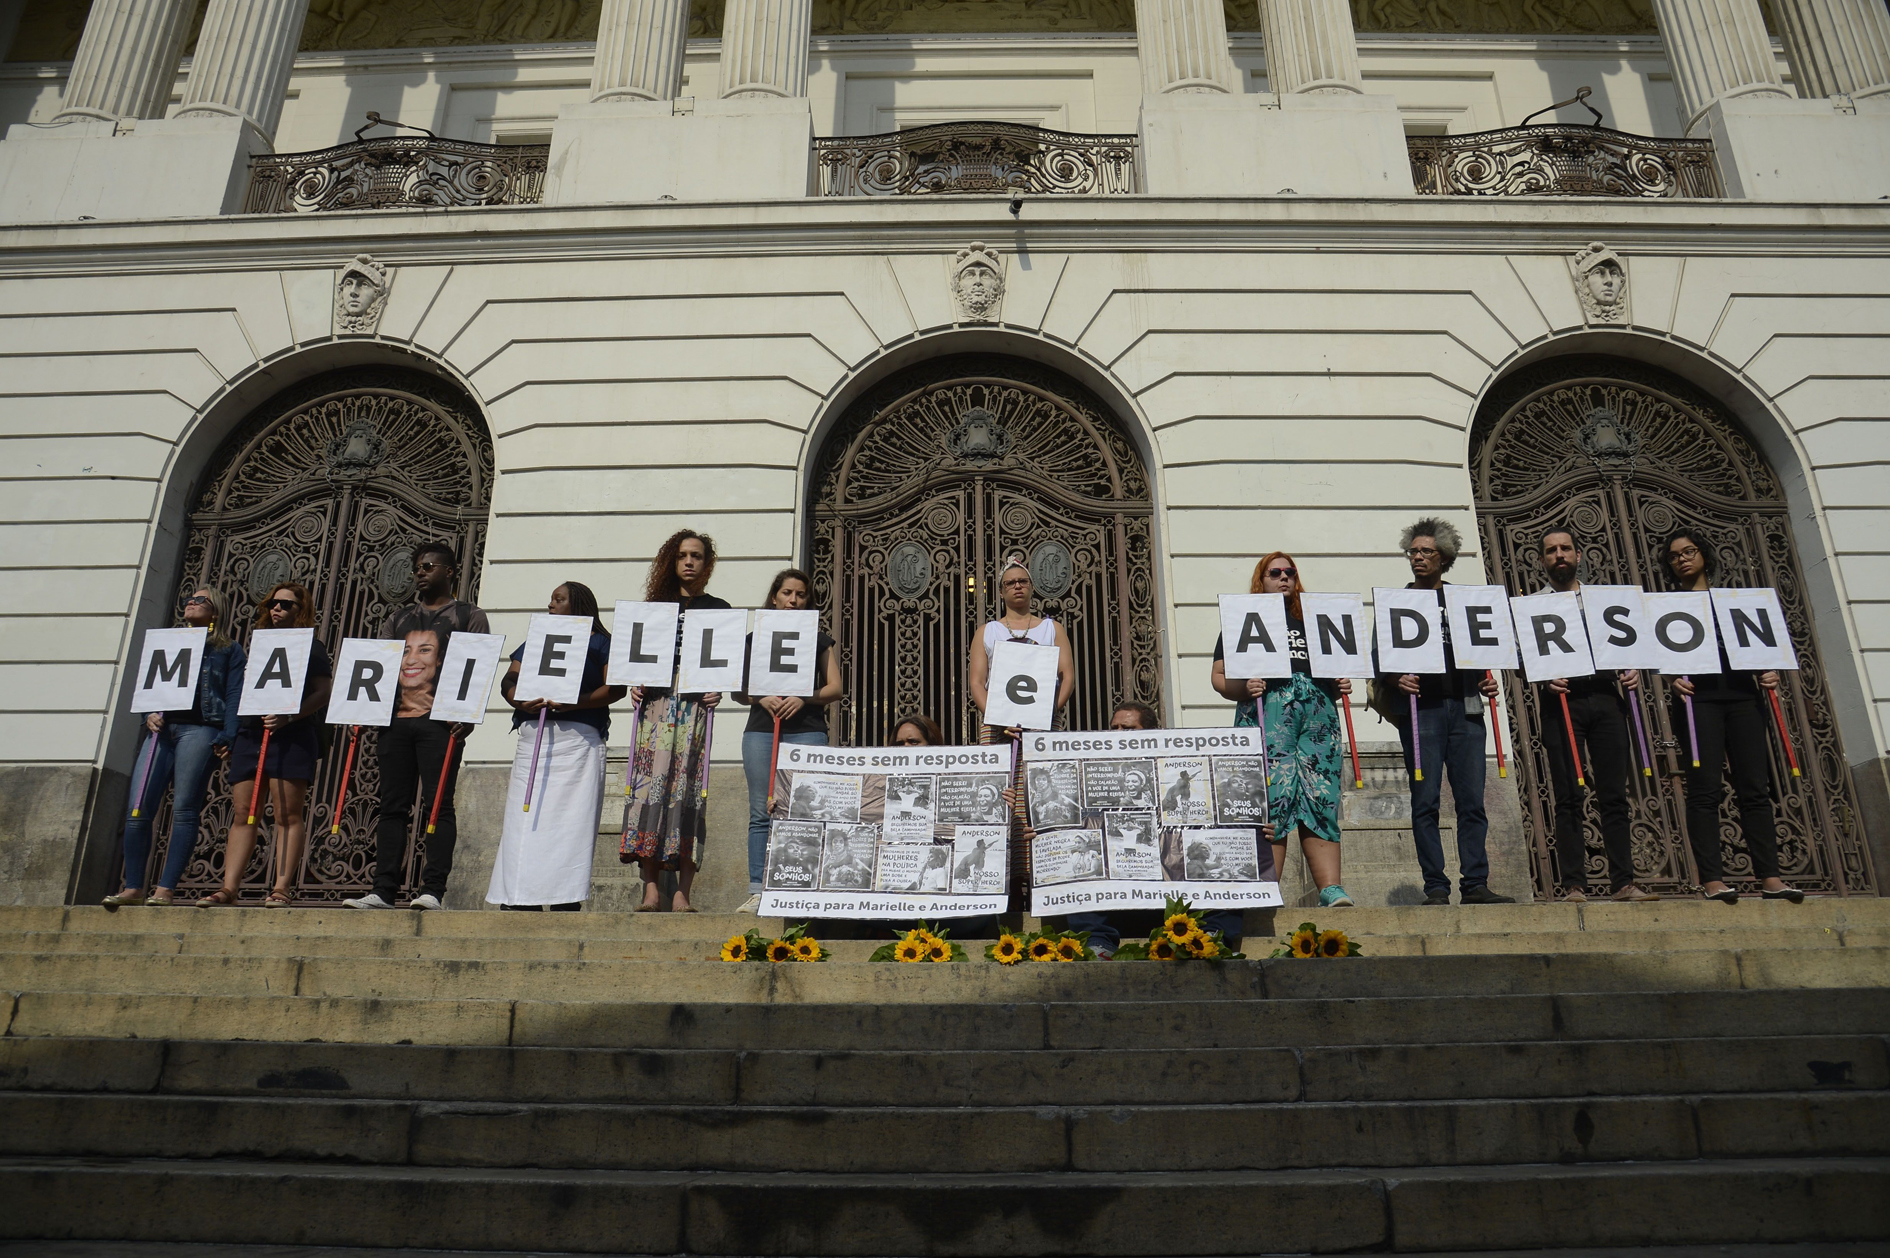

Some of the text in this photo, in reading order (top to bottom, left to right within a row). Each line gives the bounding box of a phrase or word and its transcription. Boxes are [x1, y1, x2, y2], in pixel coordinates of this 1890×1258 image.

[628, 622, 658, 664] L
[1236, 612, 1277, 653] A
[1316, 613, 1358, 655] N
[1389, 607, 1430, 649] D
[1464, 605, 1499, 646] E
[1530, 613, 1576, 656] R
[1602, 605, 1638, 647] S
[1654, 611, 1705, 653] O
[1729, 608, 1778, 648] N
[143, 647, 193, 690] M
[254, 647, 292, 689] A
[537, 633, 573, 677] E
[699, 628, 729, 668] L
[769, 630, 800, 673] E
[346, 659, 384, 703] R
[456, 658, 477, 701] I
[1005, 674, 1038, 705] e
[789, 748, 999, 769] 6 meses sem resposta
[1034, 733, 1250, 752] 6 meses sem resposta
[1164, 761, 1203, 769] ANDERSON
[1224, 807, 1262, 816] SONHOS!
[773, 872, 813, 882] SONHOS!
[1042, 889, 1271, 906] Justiça para Marielle e Anderson
[771, 898, 820, 911] Justiça
[823, 902, 855, 912] para
[858, 901, 915, 911] Marielle
[929, 902, 997, 911] Anderson
